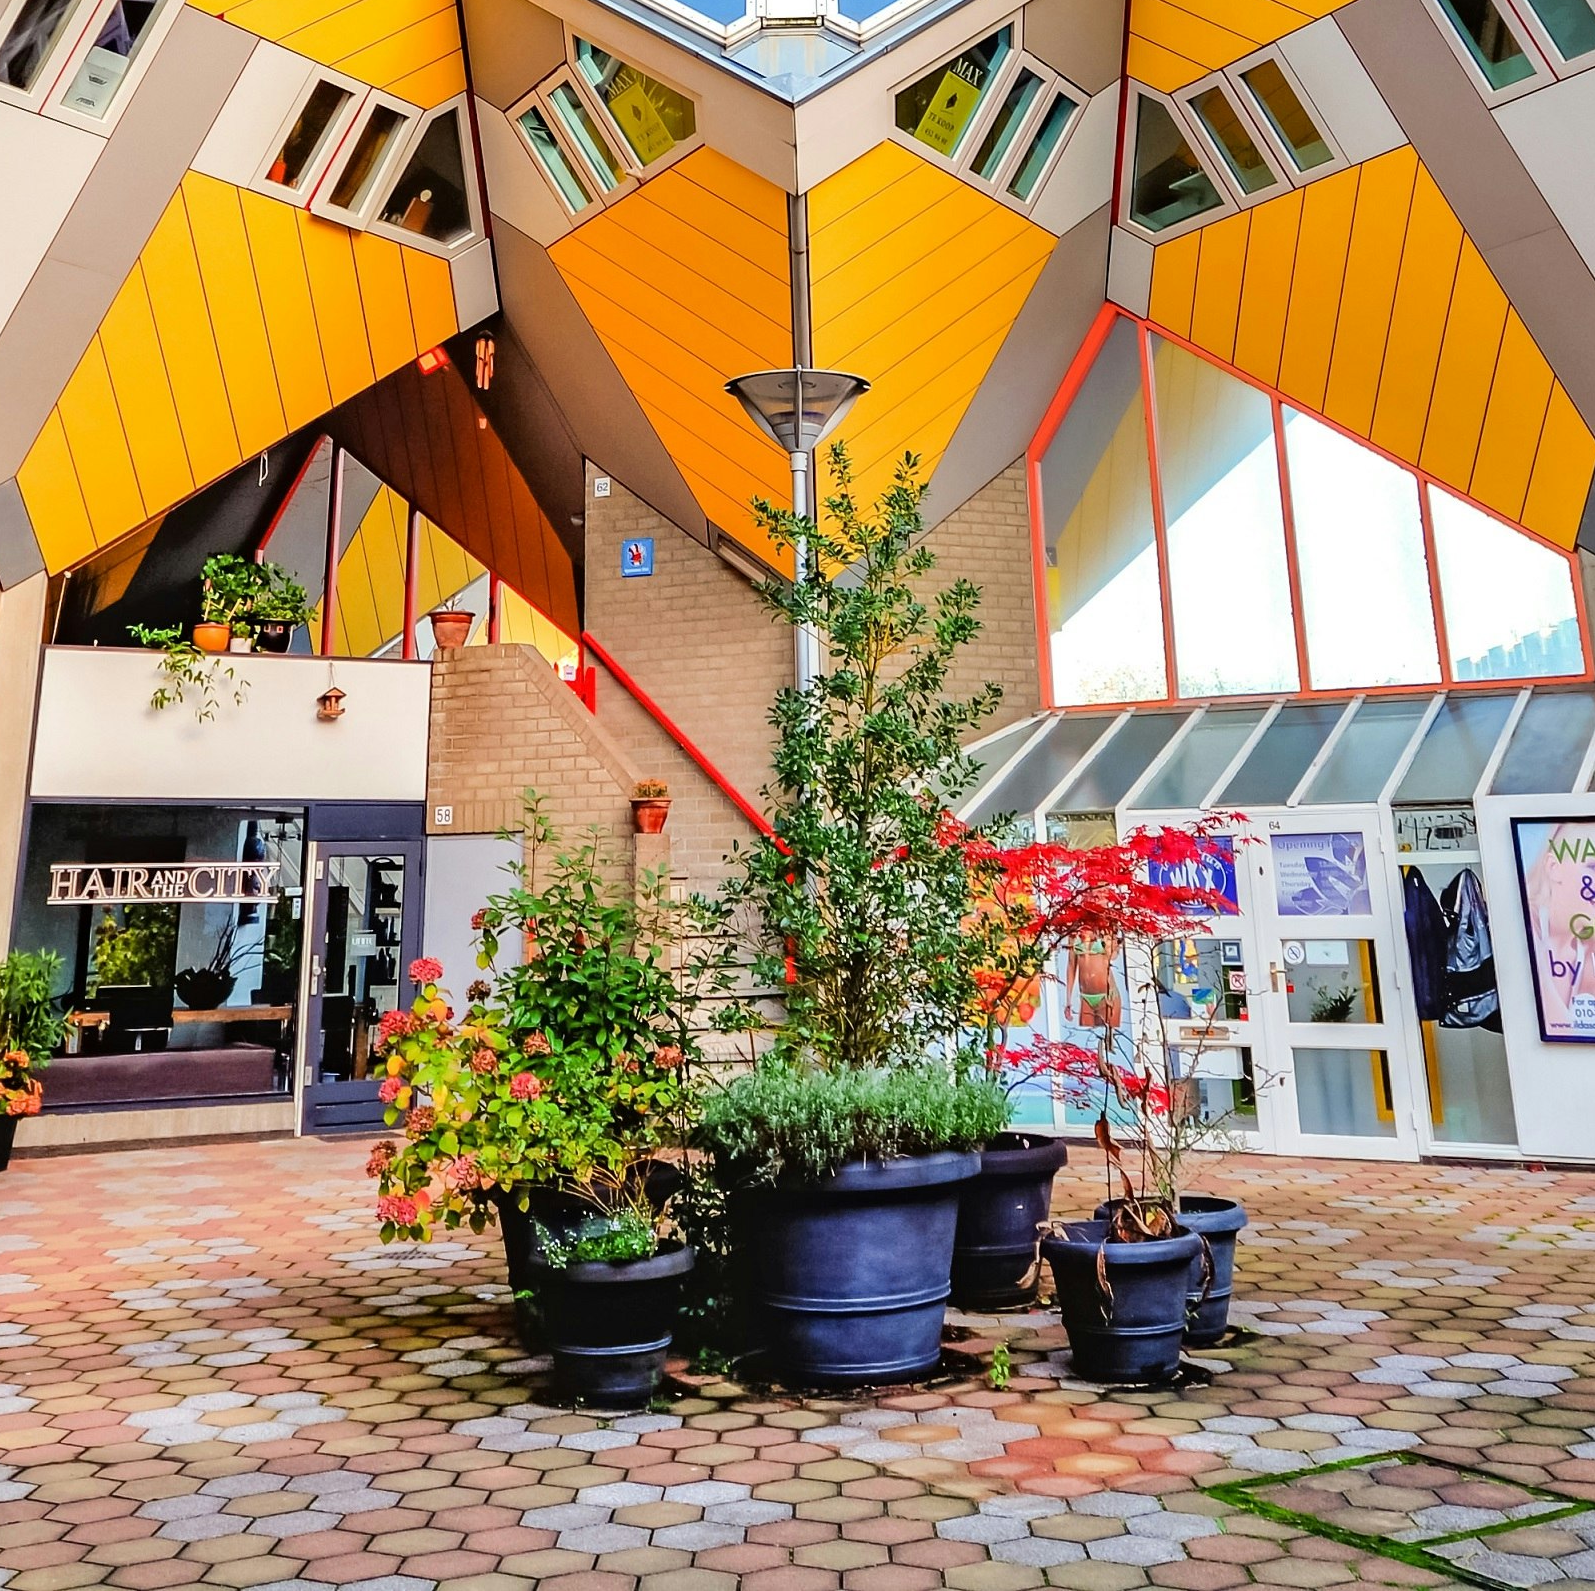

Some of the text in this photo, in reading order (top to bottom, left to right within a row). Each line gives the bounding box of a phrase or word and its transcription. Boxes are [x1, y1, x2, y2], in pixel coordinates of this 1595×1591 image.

[952, 57, 983, 86] MAX
[605, 71, 634, 99] MAX
[596, 482, 608, 492] 62
[437, 809, 450, 822] 58
[1268, 821, 1281, 830] 64
[1277, 841, 1324, 851] Opening
[47, 866, 281, 900] HAIR AND THE CITY
[1549, 950, 1581, 986] by
[1572, 997, 1585, 1006] For
